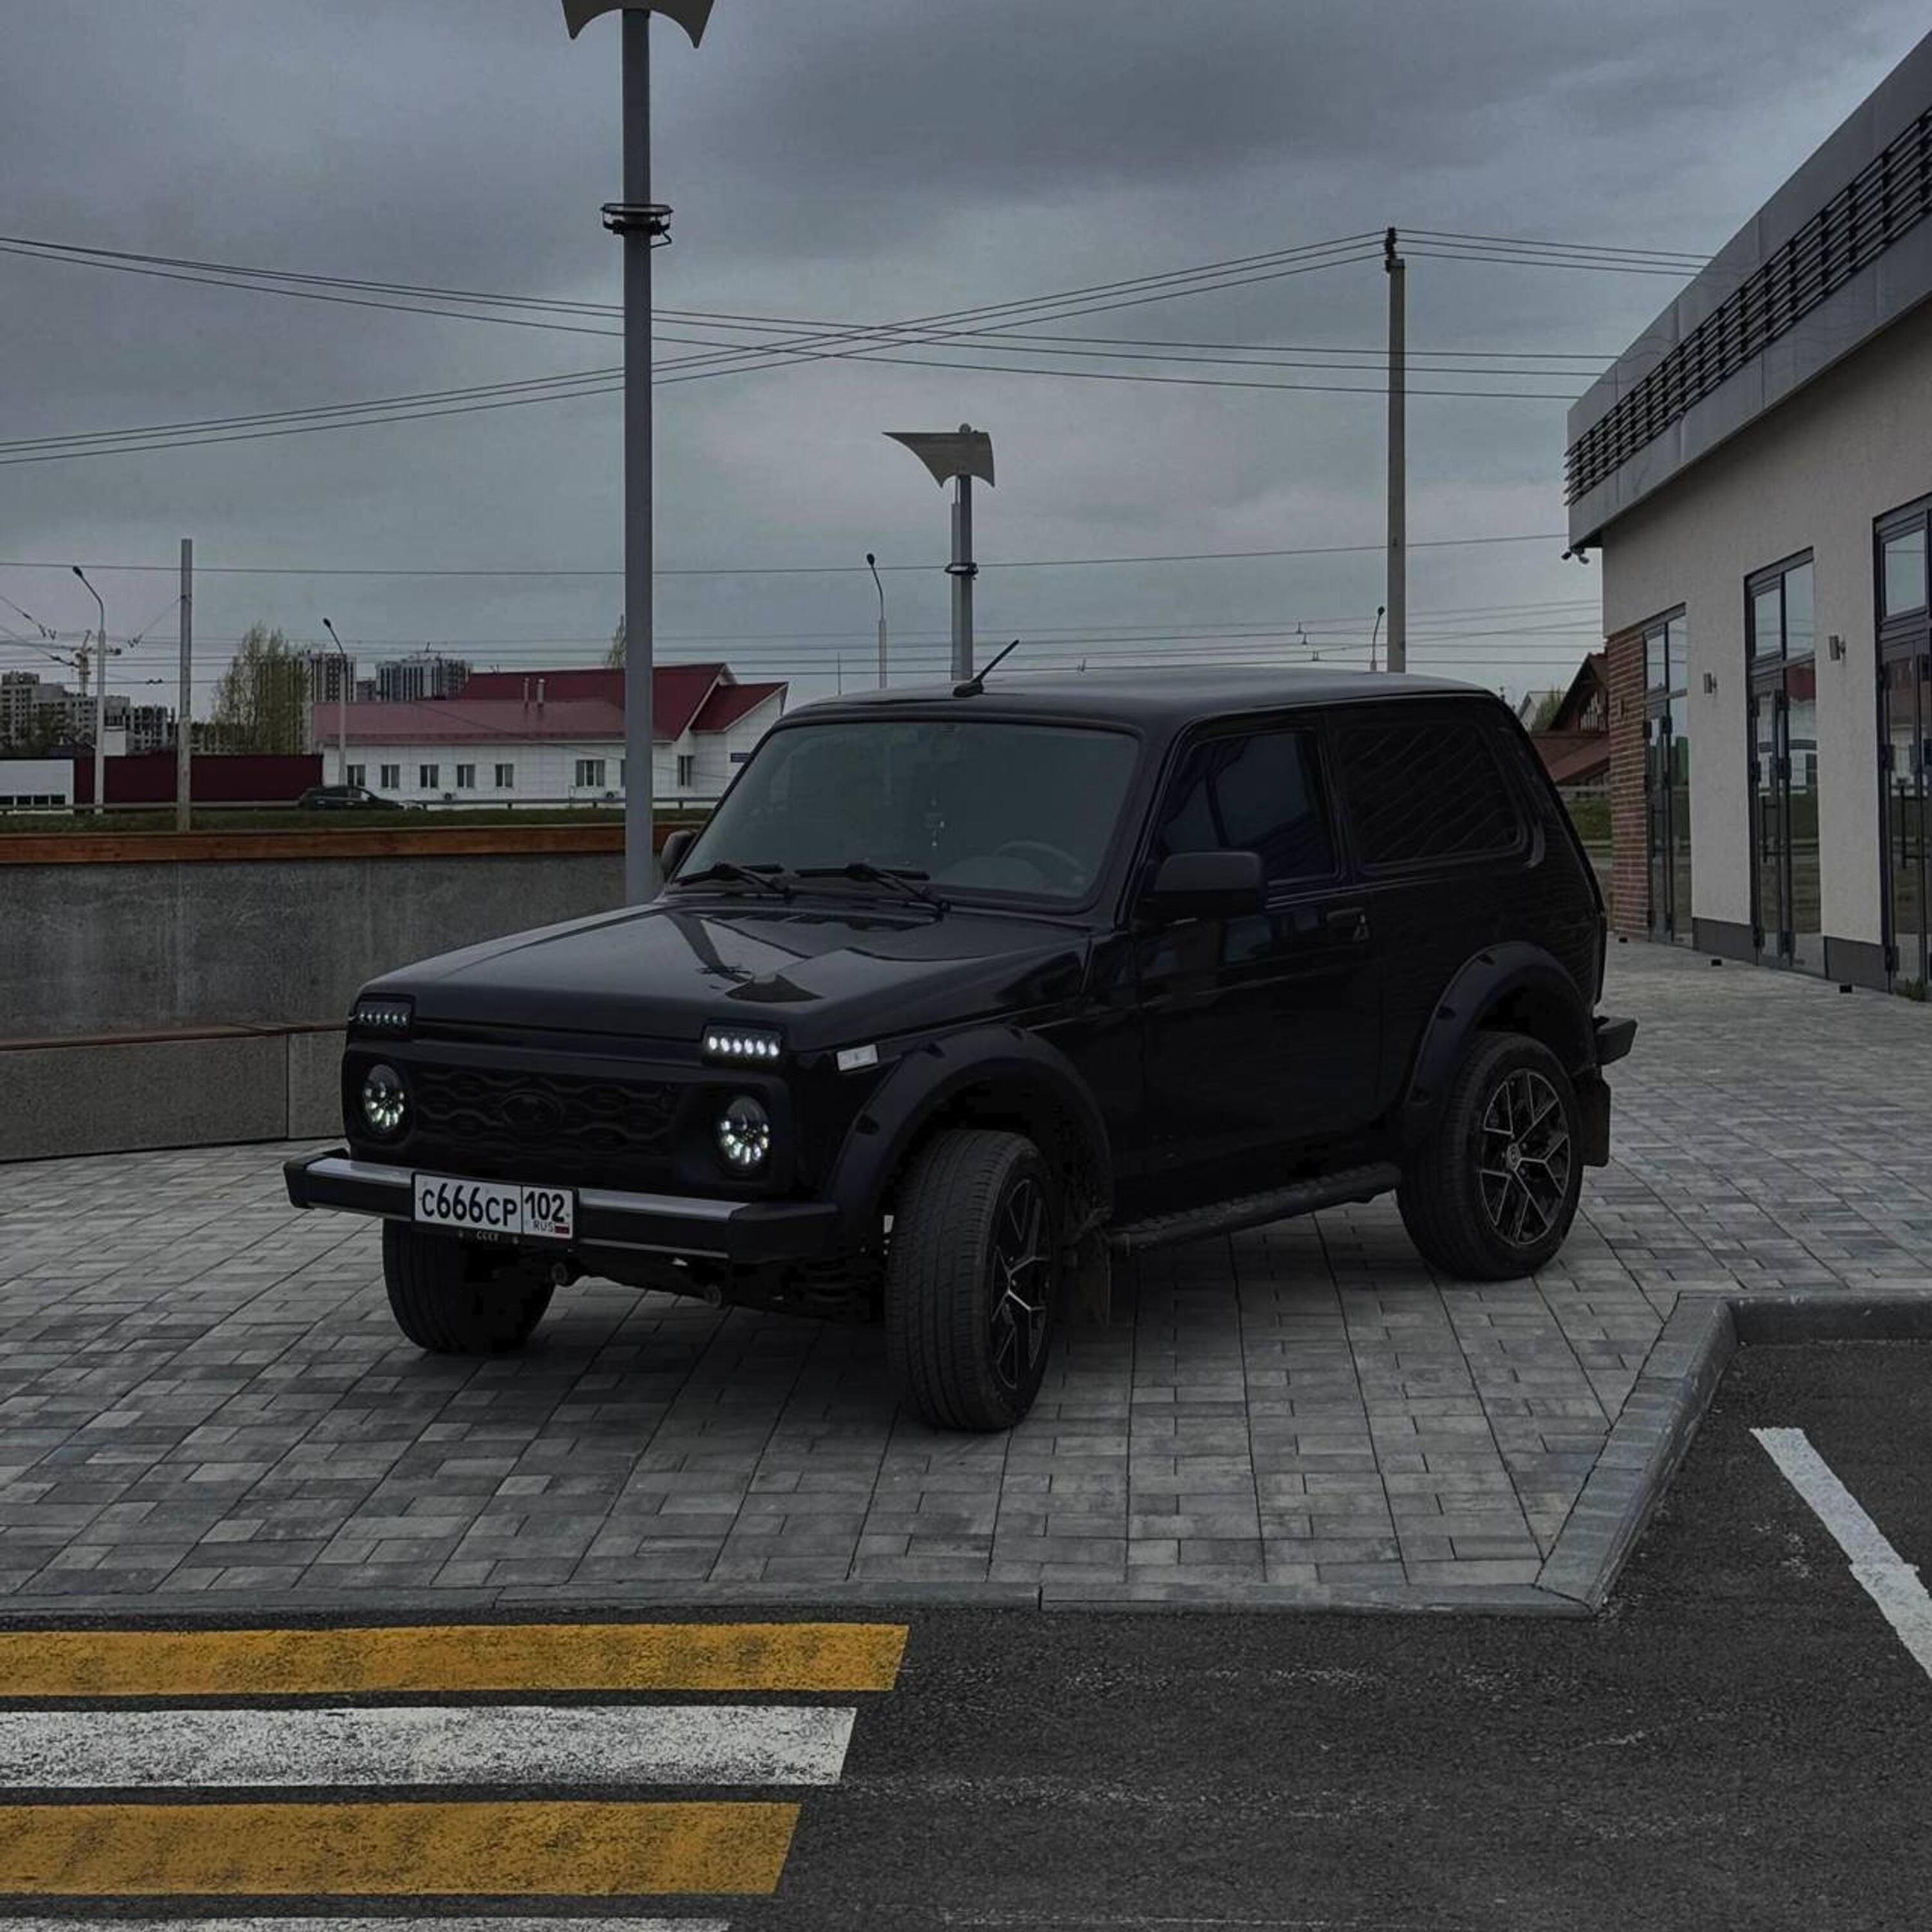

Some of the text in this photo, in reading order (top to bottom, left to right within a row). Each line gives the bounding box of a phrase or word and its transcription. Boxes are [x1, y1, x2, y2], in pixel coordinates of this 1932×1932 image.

[422, 1183, 565, 1226] С666СР 102
[533, 1220, 554, 1233] RUS
